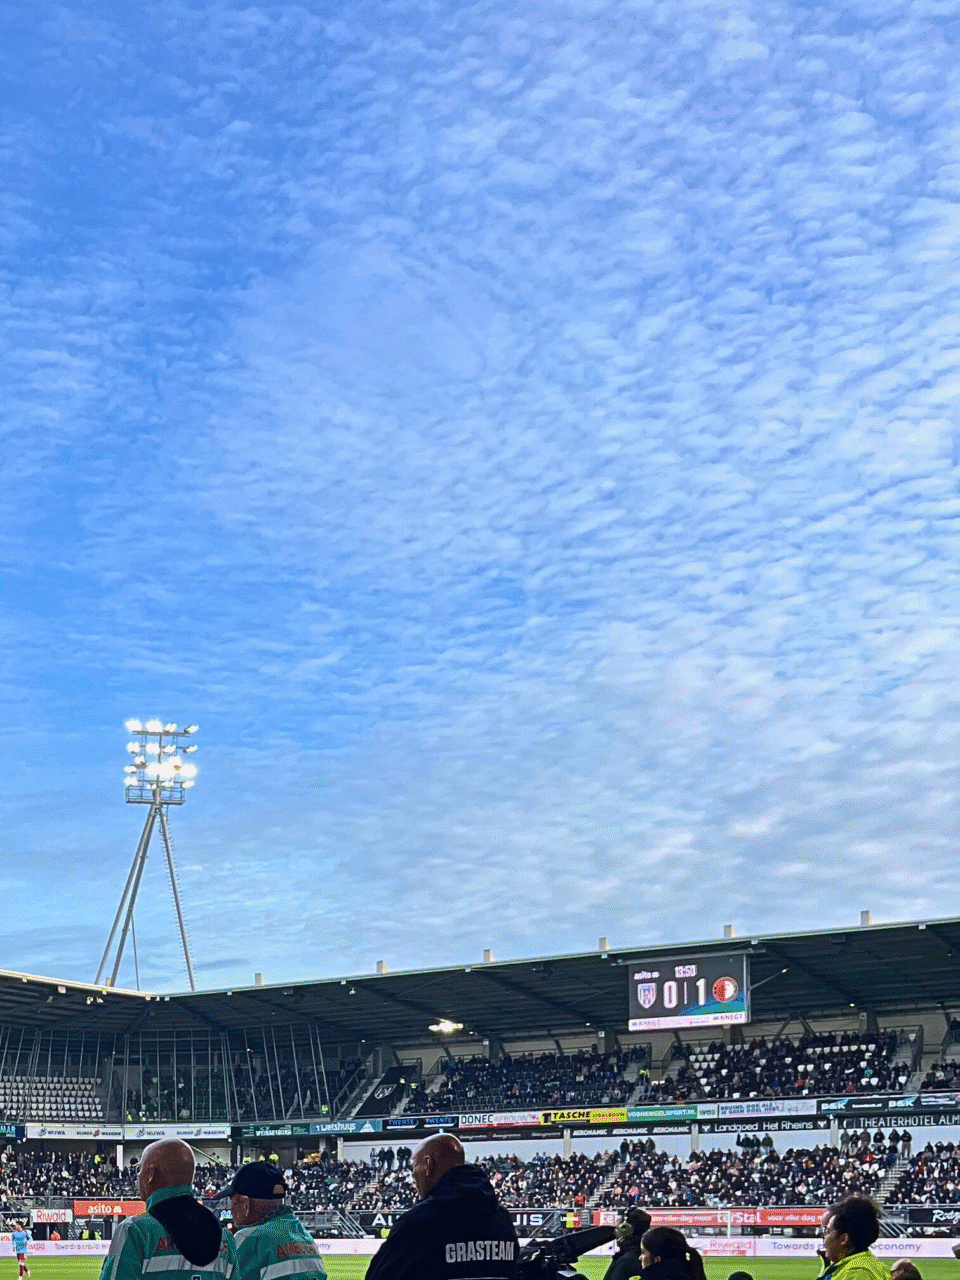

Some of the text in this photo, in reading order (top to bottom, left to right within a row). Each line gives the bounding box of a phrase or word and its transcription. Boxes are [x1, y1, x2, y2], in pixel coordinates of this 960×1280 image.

[663, 980, 678, 1008] 0
[696, 978, 707, 1006] 1
[821, 1101, 846, 1111] B&K
[888, 1097, 915, 1108] B&K
[553, 1111, 590, 1120] TASCHE
[859, 1115, 960, 1128] THEATERHOTEL ALM
[714, 1119, 814, 1134] Landgoed Het Rheins
[36, 1209, 67, 1222] Riwald
[87, 1204, 114, 1214] asito
[716, 1209, 762, 1224] terStal
[445, 1240, 515, 1263] GRASTEAM
[771, 1241, 815, 1250] Towards
